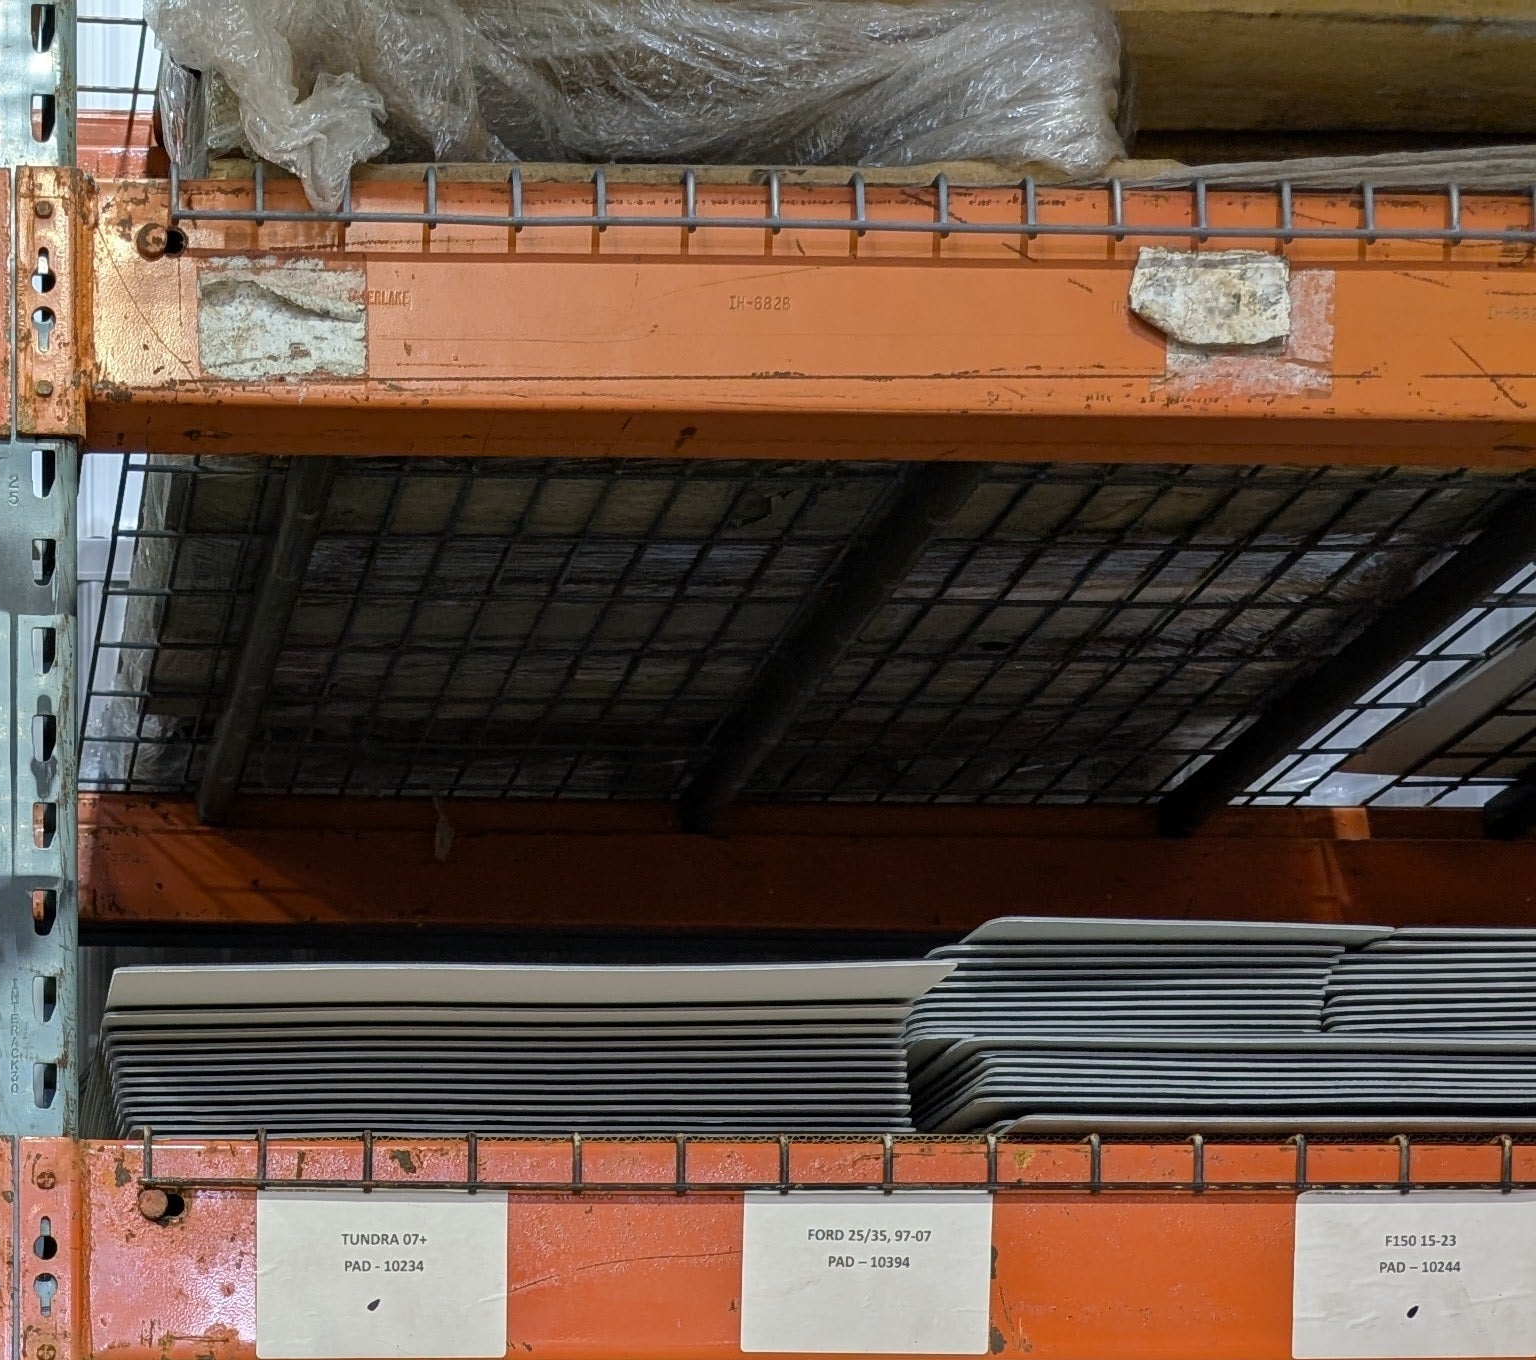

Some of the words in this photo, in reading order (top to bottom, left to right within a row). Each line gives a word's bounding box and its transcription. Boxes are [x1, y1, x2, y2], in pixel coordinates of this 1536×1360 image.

[341, 1233, 400, 1246] TUNDRA
[402, 1233, 428, 1246] 07+
[807, 1228, 845, 1241] FORD
[848, 1228, 891, 1244] 25/35,
[894, 1229, 932, 1242] 97-07
[1385, 1234, 1417, 1247] F150
[1420, 1234, 1457, 1247] 15-23
[344, 1260, 372, 1272] PAD
[384, 1259, 424, 1272] 10234
[828, 1255, 855, 1268] PAD
[870, 1256, 911, 1269] 10394
[1379, 1261, 1406, 1274] PAD
[1421, 1261, 1461, 1273] 10244
